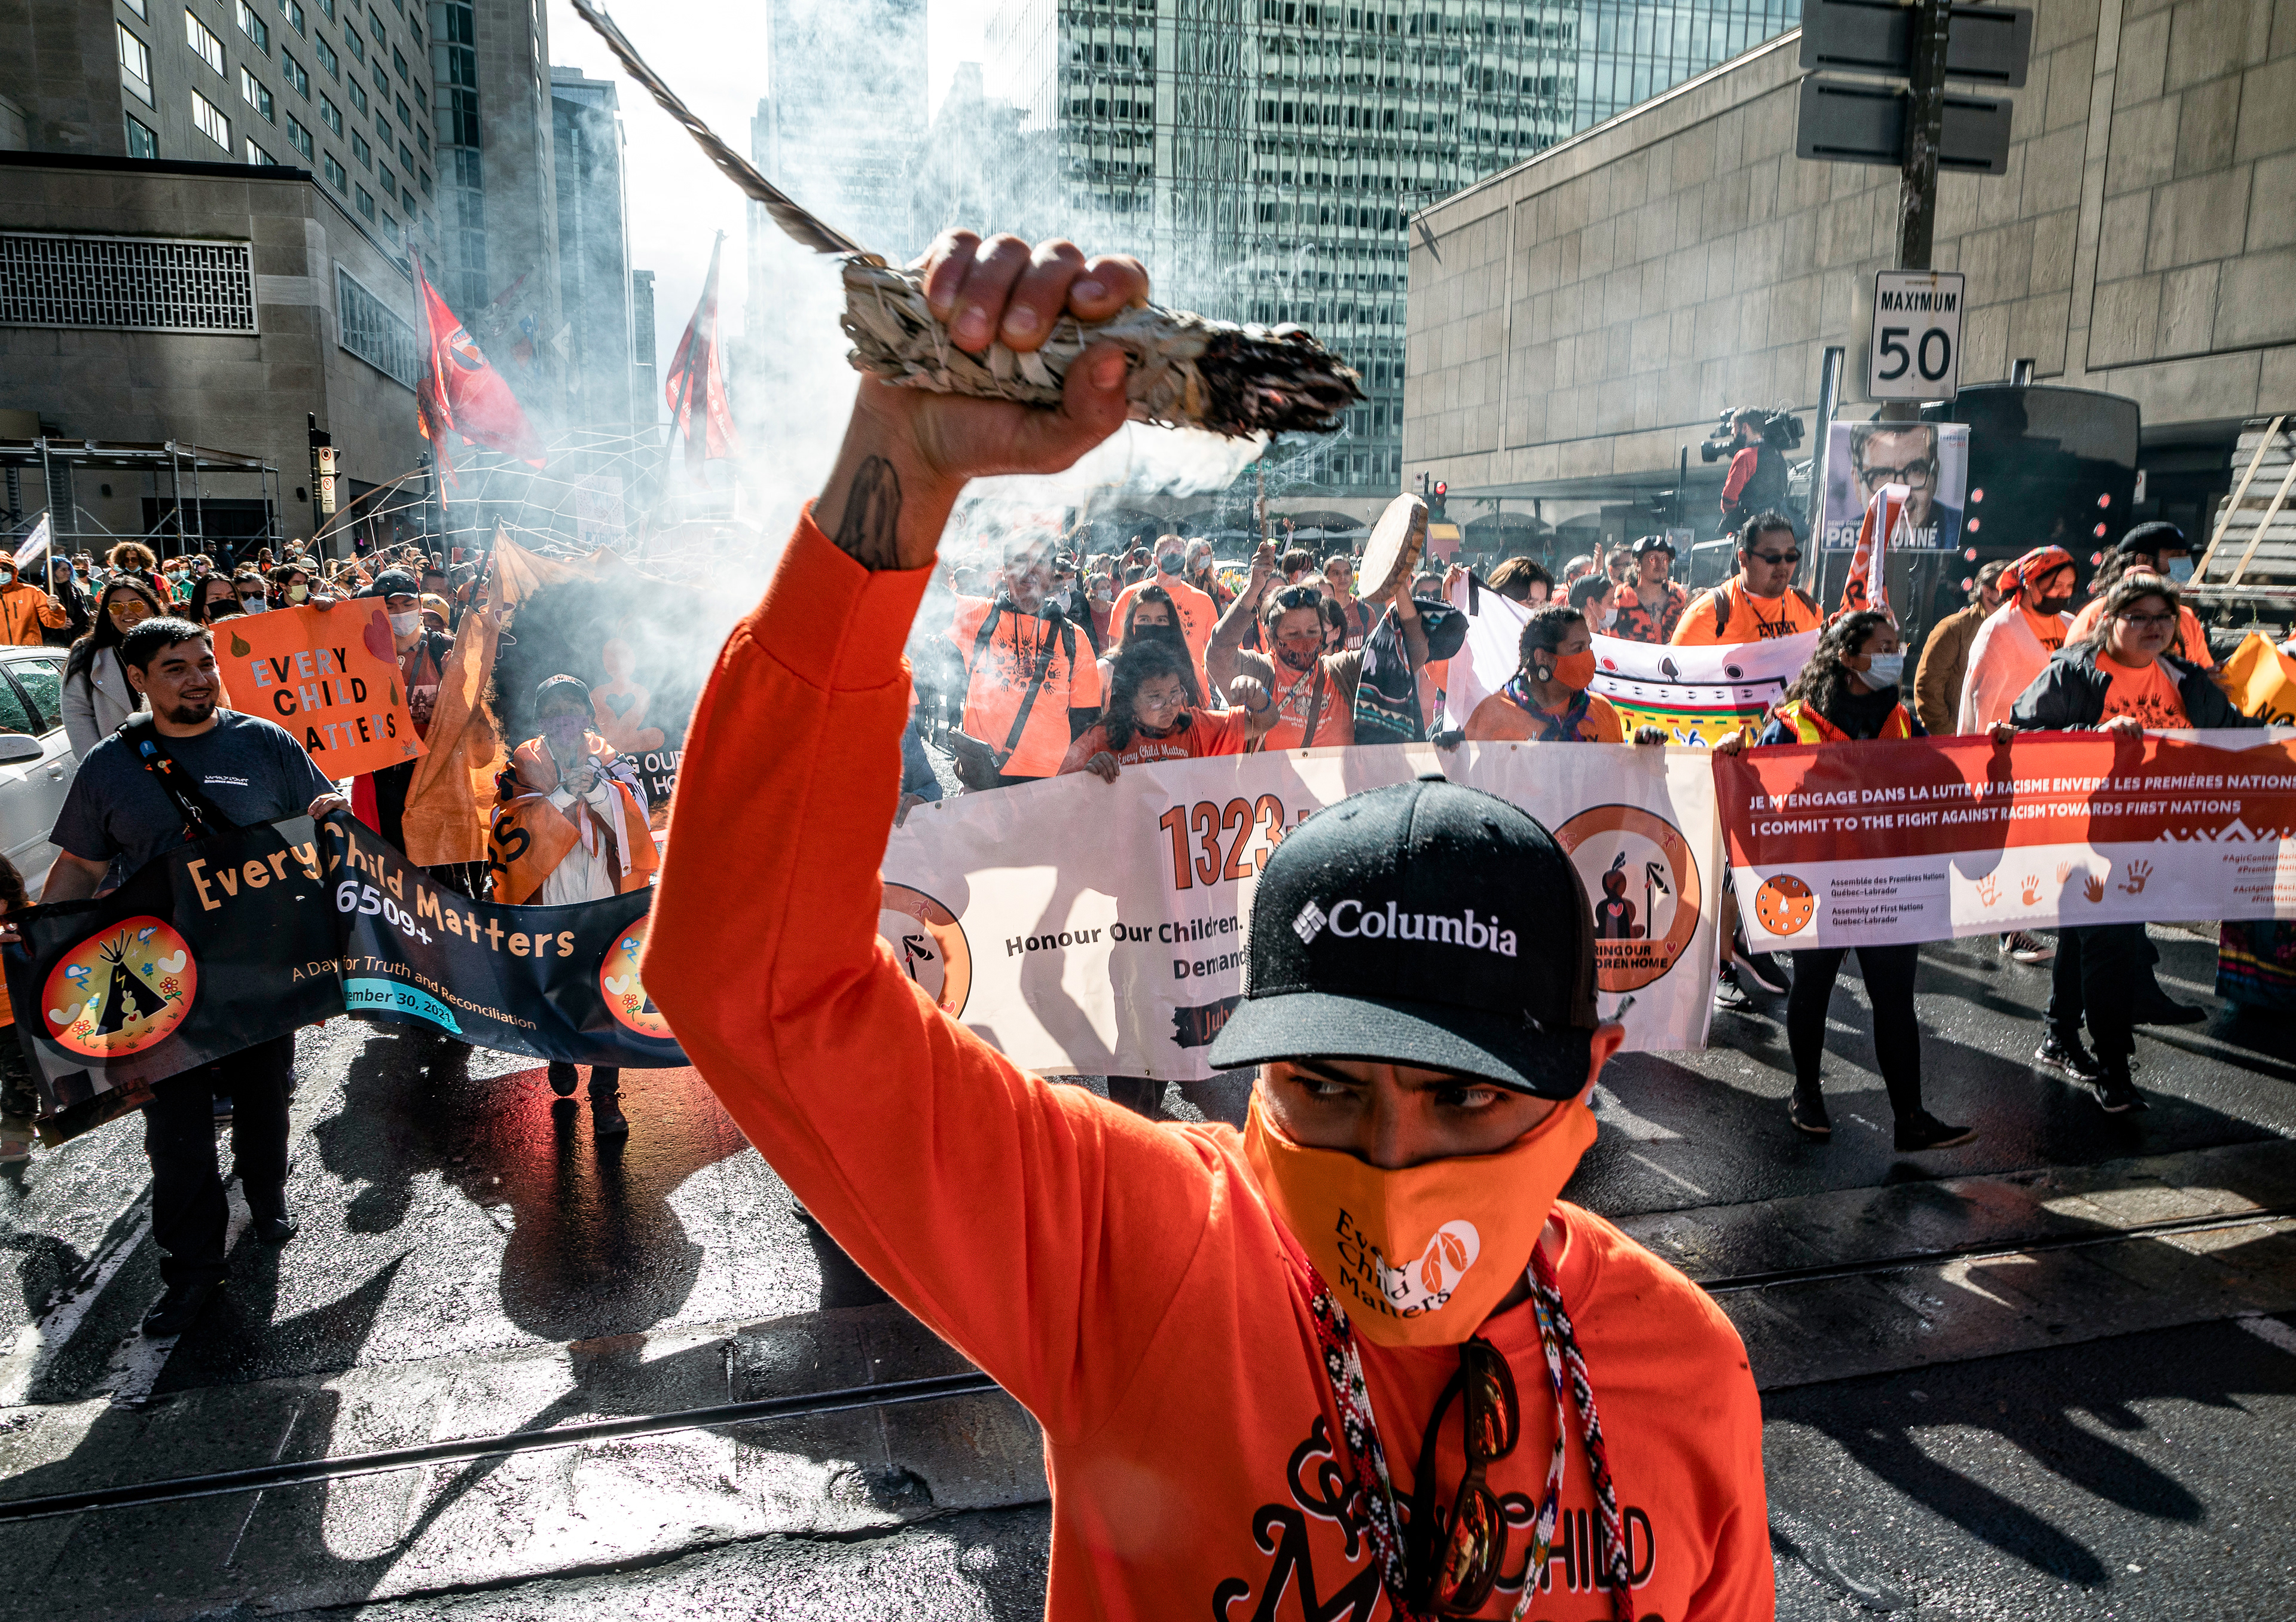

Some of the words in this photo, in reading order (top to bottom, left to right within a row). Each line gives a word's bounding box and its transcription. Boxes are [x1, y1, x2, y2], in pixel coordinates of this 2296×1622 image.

[1881, 291, 1956, 312] MAXIMUM
[1878, 327, 1951, 381] 50
[1826, 521, 1938, 548] PASONNÉ
[251, 647, 347, 688] EVERY
[273, 677, 367, 717] CHILD
[306, 713, 396, 754] ATTERS
[1118, 752, 1139, 765] Every
[1139, 743, 1160, 758] Child
[1161, 743, 1189, 758] Matters
[652, 775, 679, 795] HO
[1750, 795, 1764, 810] JE
[1769, 790, 1857, 809] M'ENGAGE
[1862, 787, 1906, 803] DANS
[1910, 785, 1929, 800] LA
[1932, 783, 1971, 799] LUTTE
[1973, 782, 1994, 797] AU
[1997, 778, 2050, 795] RACISME
[2053, 777, 2109, 792] ENVERS
[2114, 776, 2141, 790] LES
[2144, 773, 2223, 790] PREMIÈRES
[1751, 822, 1756, 837] I
[1760, 818, 1829, 836] COMMIT
[1833, 816, 1858, 831] TO
[1861, 814, 1894, 830] THE
[1897, 812, 1938, 828] FIGHT
[1941, 807, 1998, 825] AGAINST
[2001, 803, 2046, 821] RACISM
[2048, 801, 2123, 817] TOWARDS
[2126, 800, 2167, 815] FIRST
[2170, 800, 2241, 814] NATIONS
[1159, 793, 1309, 891] 1323
[187, 841, 323, 911] Every
[323, 822, 404, 901] Child
[416, 888, 575, 958] Matters
[1831, 877, 1872, 886] Assemblée
[1889, 874, 1922, 884] Premières
[1923, 873, 1945, 881] Nations
[2233, 883, 2296, 894] #ActAgainstRaci
[335, 880, 433, 944] 6509+
[1832, 905, 1869, 915] Assembly
[1870, 905, 1879, 914] of
[1880, 904, 1898, 913] First
[1899, 903, 1923, 912] Nations
[1006, 927, 1101, 956] Honour
[1110, 922, 1153, 943] Our
[1158, 913, 1244, 944] Children.
[1328, 899, 1518, 957] Columbia
[1595, 946, 1623, 955] RING
[1625, 946, 1651, 955] OUR
[1595, 958, 1628, 968] DREN
[1631, 958, 1668, 968] HOME
[292, 967, 306, 982] A
[310, 958, 338, 980] Day
[343, 955, 360, 971] for
[364, 955, 411, 980] Truth
[414, 969, 439, 995] and
[441, 985, 538, 1031] Reconciliation
[344, 989, 393, 1002] tember
[396, 993, 419, 1010] 30,
[423, 1001, 451, 1023] 2021
[1335, 1208, 1412, 1276] Evey
